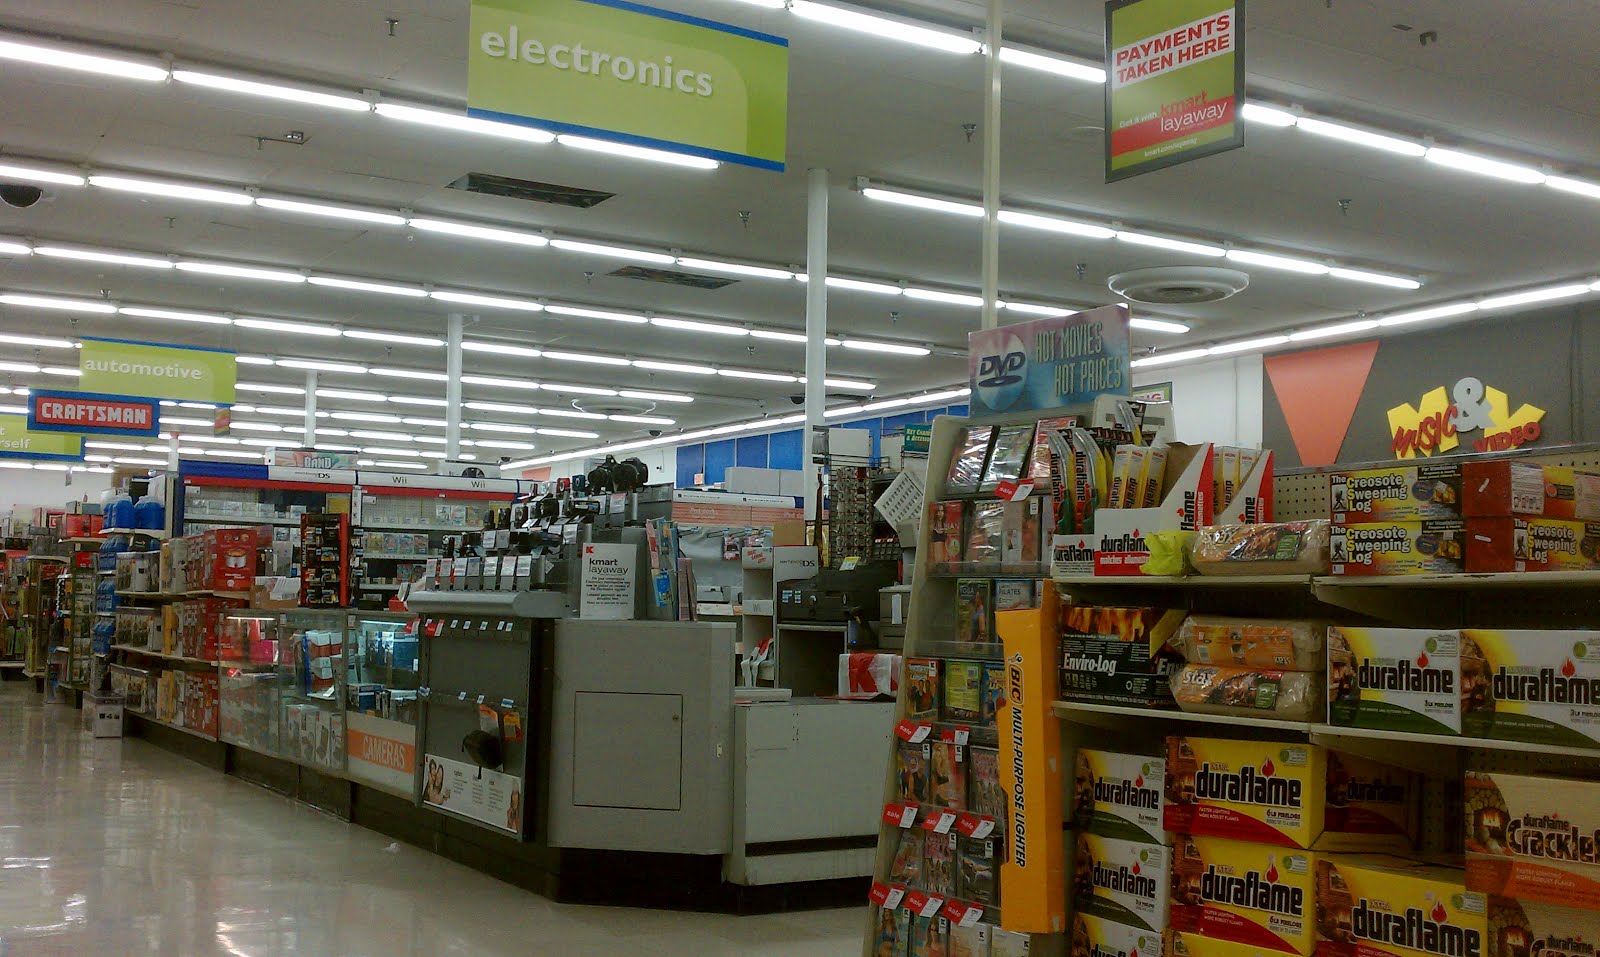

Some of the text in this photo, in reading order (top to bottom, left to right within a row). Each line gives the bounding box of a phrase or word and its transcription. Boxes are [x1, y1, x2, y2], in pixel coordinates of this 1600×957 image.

[1116, 14, 1230, 66] PAYMENTS
[480, 25, 713, 97] electronics
[1116, 33, 1230, 84] TAKEN HERE
[1160, 88, 1208, 116] kmart
[1160, 102, 1228, 132] layaway
[1035, 323, 1104, 364] HOT MOVIES
[84, 357, 202, 379] automotive
[980, 352, 1026, 376] DVD
[1055, 357, 1122, 397] HOT PRICES
[41, 402, 147, 425] CRAFTSMAN
[1391, 404, 1458, 457] MUSIC
[1472, 421, 1542, 452] VIDEO
[304, 456, 332, 469] BAND
[391, 476, 407, 484] Wii
[471, 480, 486, 489] Wii
[1050, 453, 1062, 503] duraflame
[1075, 451, 1086, 501] duraflame
[1331, 473, 1404, 489] The Creosote
[999, 486, 1014, 495] sale
[1346, 485, 1408, 501] Sweeping
[1347, 501, 1372, 513] Log
[1330, 526, 1407, 541] The Creosote
[1513, 518, 1528, 528] The
[1527, 523, 1575, 539] Creosote
[1346, 538, 1411, 554] Sweeping
[1527, 536, 1577, 556] Sweeping
[1528, 548, 1548, 564] Log
[588, 565, 629, 575] layaway
[589, 558, 618, 566] kmart
[1347, 552, 1373, 565] Log
[1063, 653, 1118, 677] Enviro-Log
[1358, 657, 1454, 694] duraflame
[1010, 667, 1021, 702] BIC
[1493, 666, 1600, 705] duraflame
[899, 724, 913, 735] sale
[362, 736, 406, 770] CAMERAS
[1012, 706, 1025, 812] MULTI-PURPOSE
[1094, 776, 1160, 810] duraflame
[1196, 763, 1302, 807] duraflame
[886, 810, 900, 818] sale
[960, 819, 975, 830] sale
[1523, 813, 1570, 831] duraflame
[1015, 811, 1026, 868] LIGHTER
[1093, 861, 1157, 899] duraflame
[1202, 865, 1303, 916] duraflame
[872, 889, 886, 899] sale
[910, 897, 923, 907] sale
[946, 906, 962, 917] sale
[1353, 899, 1481, 957] duraflame
